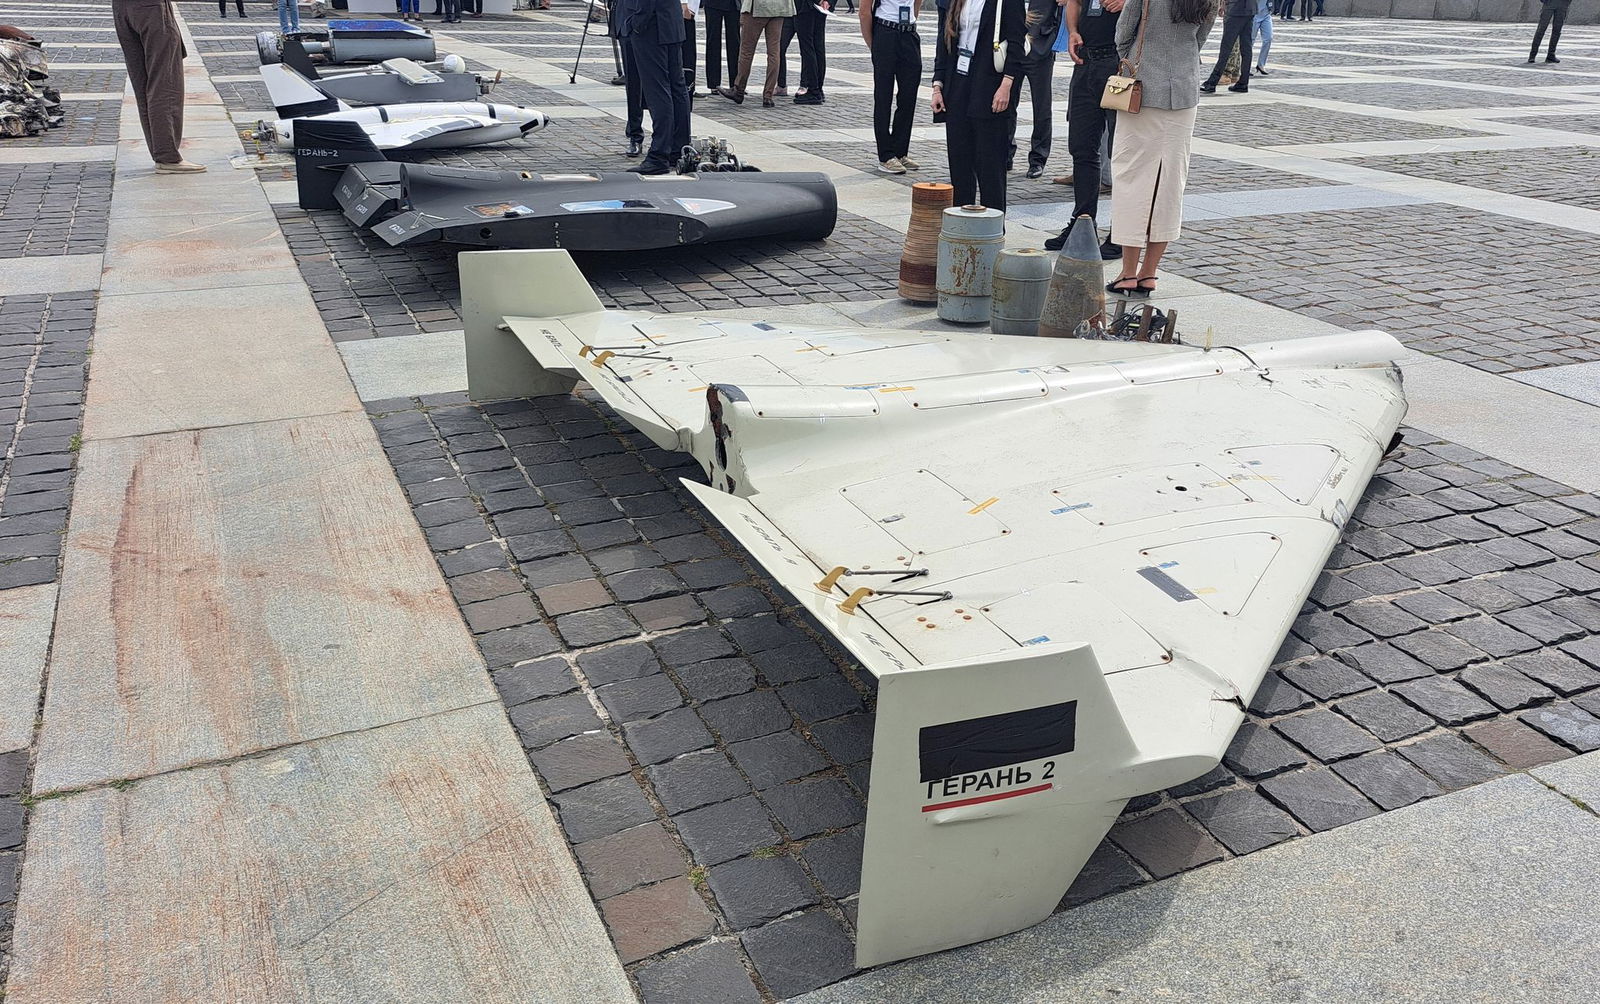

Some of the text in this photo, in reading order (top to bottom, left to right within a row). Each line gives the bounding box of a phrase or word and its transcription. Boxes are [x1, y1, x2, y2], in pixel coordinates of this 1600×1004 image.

[297, 148, 339, 157] ГЕРАНЬ-2
[860, 631, 886, 649] НЕ
[926, 760, 1056, 799] ГЕРАНЬ 2
